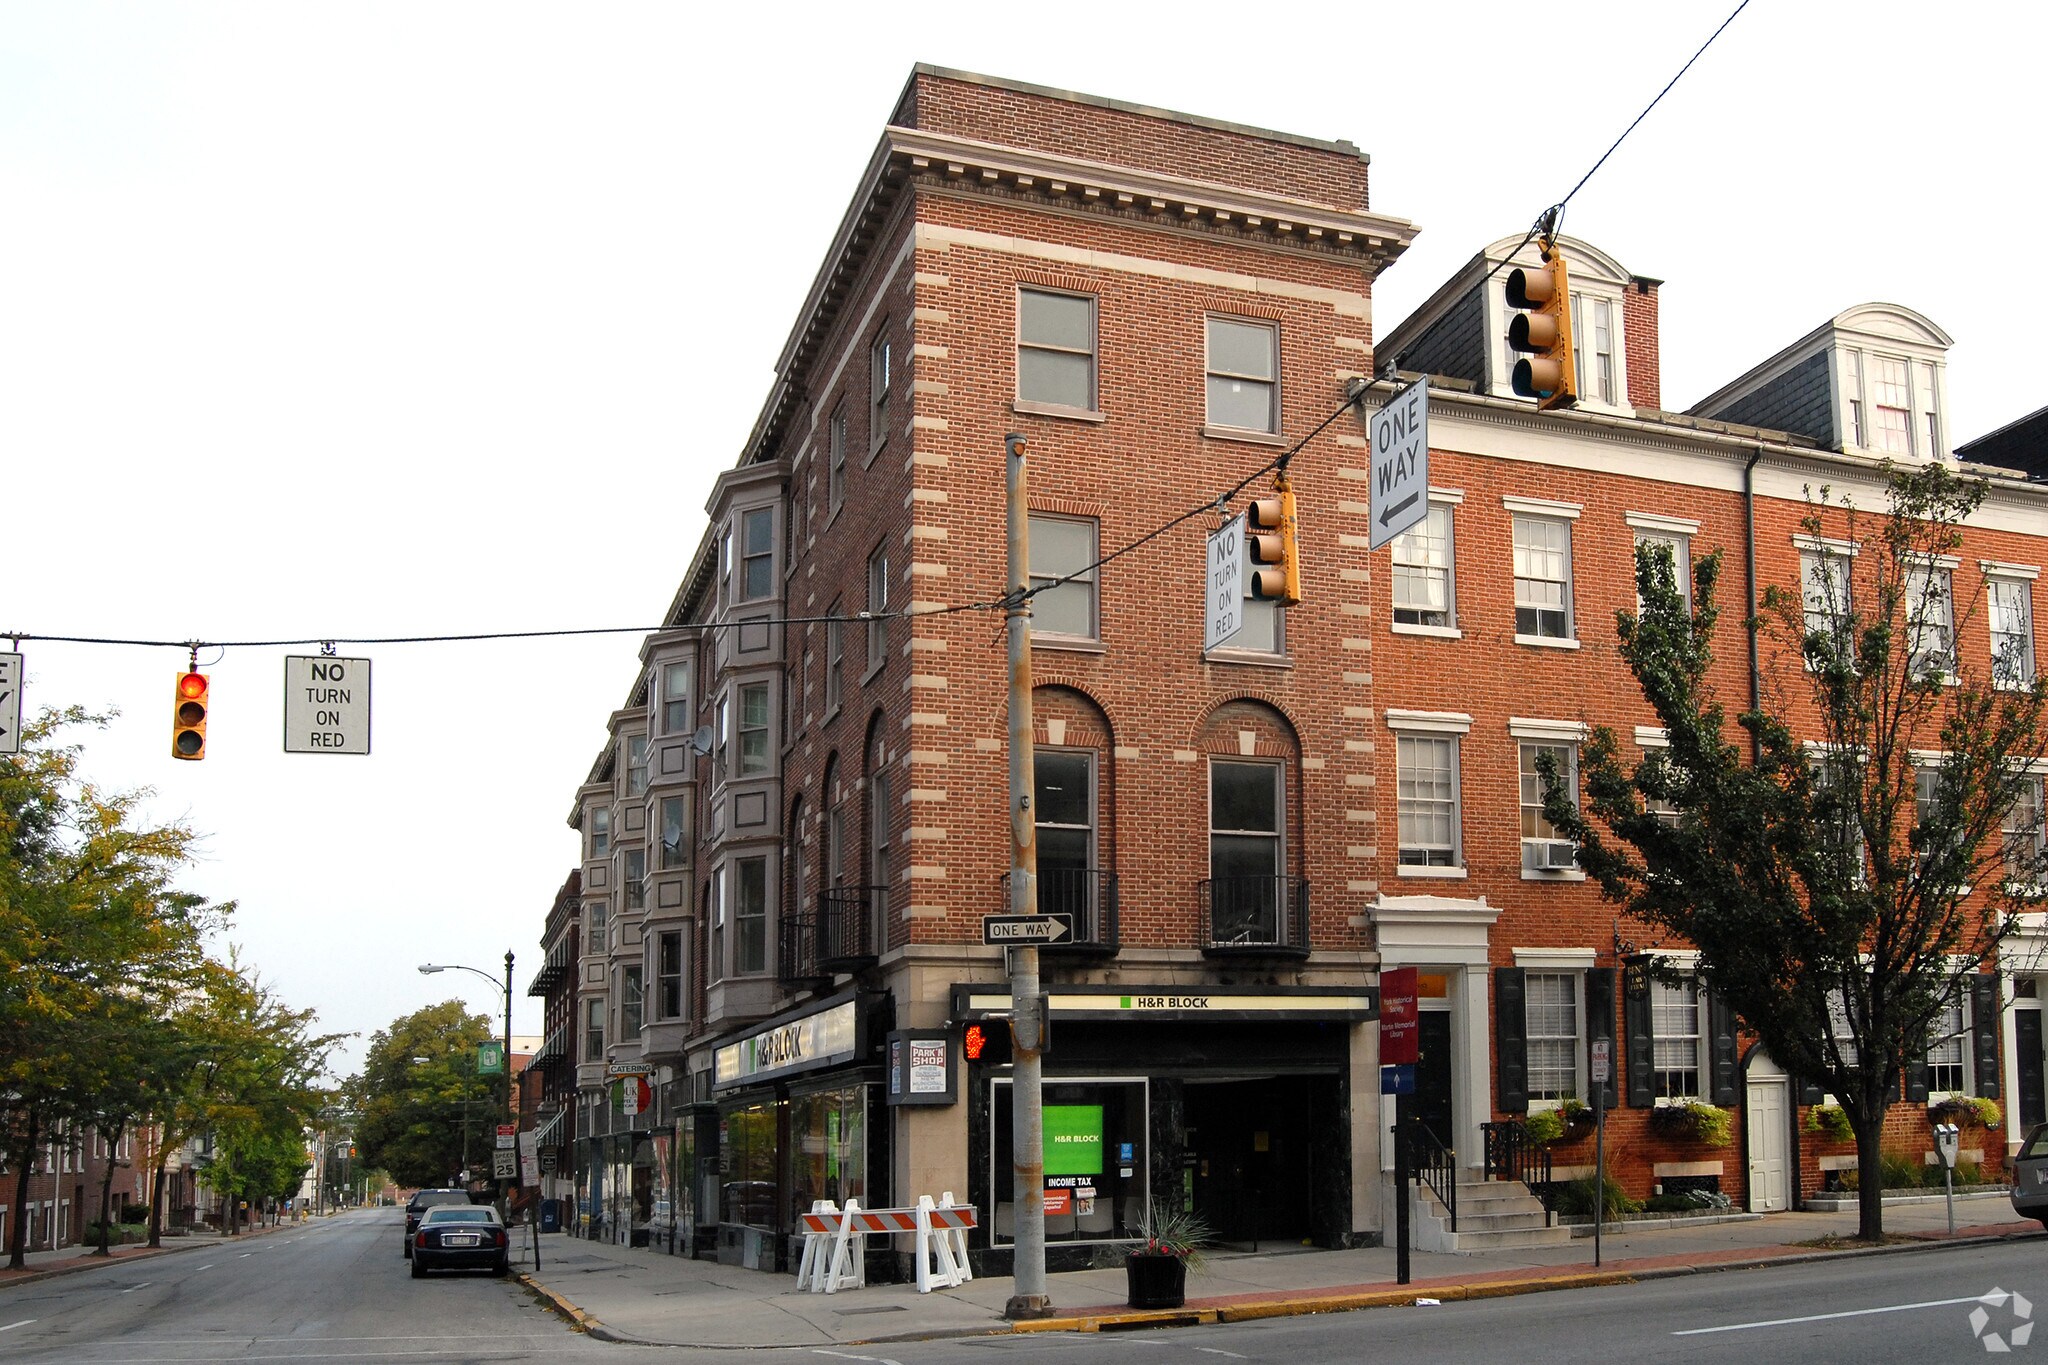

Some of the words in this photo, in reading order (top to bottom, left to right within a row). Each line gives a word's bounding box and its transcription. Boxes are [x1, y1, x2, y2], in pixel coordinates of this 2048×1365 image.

[1379, 396, 1419, 454] ONE
[1378, 439, 1420, 497] WAY
[1216, 531, 1235, 565] NO
[1214, 559, 1237, 590] TURN
[1218, 587, 1232, 611] ON
[1215, 612, 1233, 638] RED
[311, 663, 345, 682] NO
[305, 688, 351, 704] TURN
[316, 710, 340, 726] ON
[310, 732, 345, 748] RED
[993, 924, 1019, 937] ONE
[1025, 923, 1052, 936] WAY
[1138, 997, 1165, 1008] H&R
[1168, 997, 1209, 1008] BLOCK
[1392, 995, 1413, 1005] Historical
[1389, 1005, 1405, 1014] Society
[1394, 1020, 1416, 1030] Memorial
[774, 1025, 802, 1063] BLOCK
[610, 1064, 652, 1073] CATERING
[912, 1057, 944, 1066] SHOP
[1054, 1135, 1072, 1143] H&R
[1073, 1134, 1099, 1143] BLOCK
[495, 1152, 515, 1160] SPEED
[496, 1164, 515, 1176] 25
[1048, 1177, 1076, 1187] INCOME
[1077, 1176, 1092, 1186] TAX
